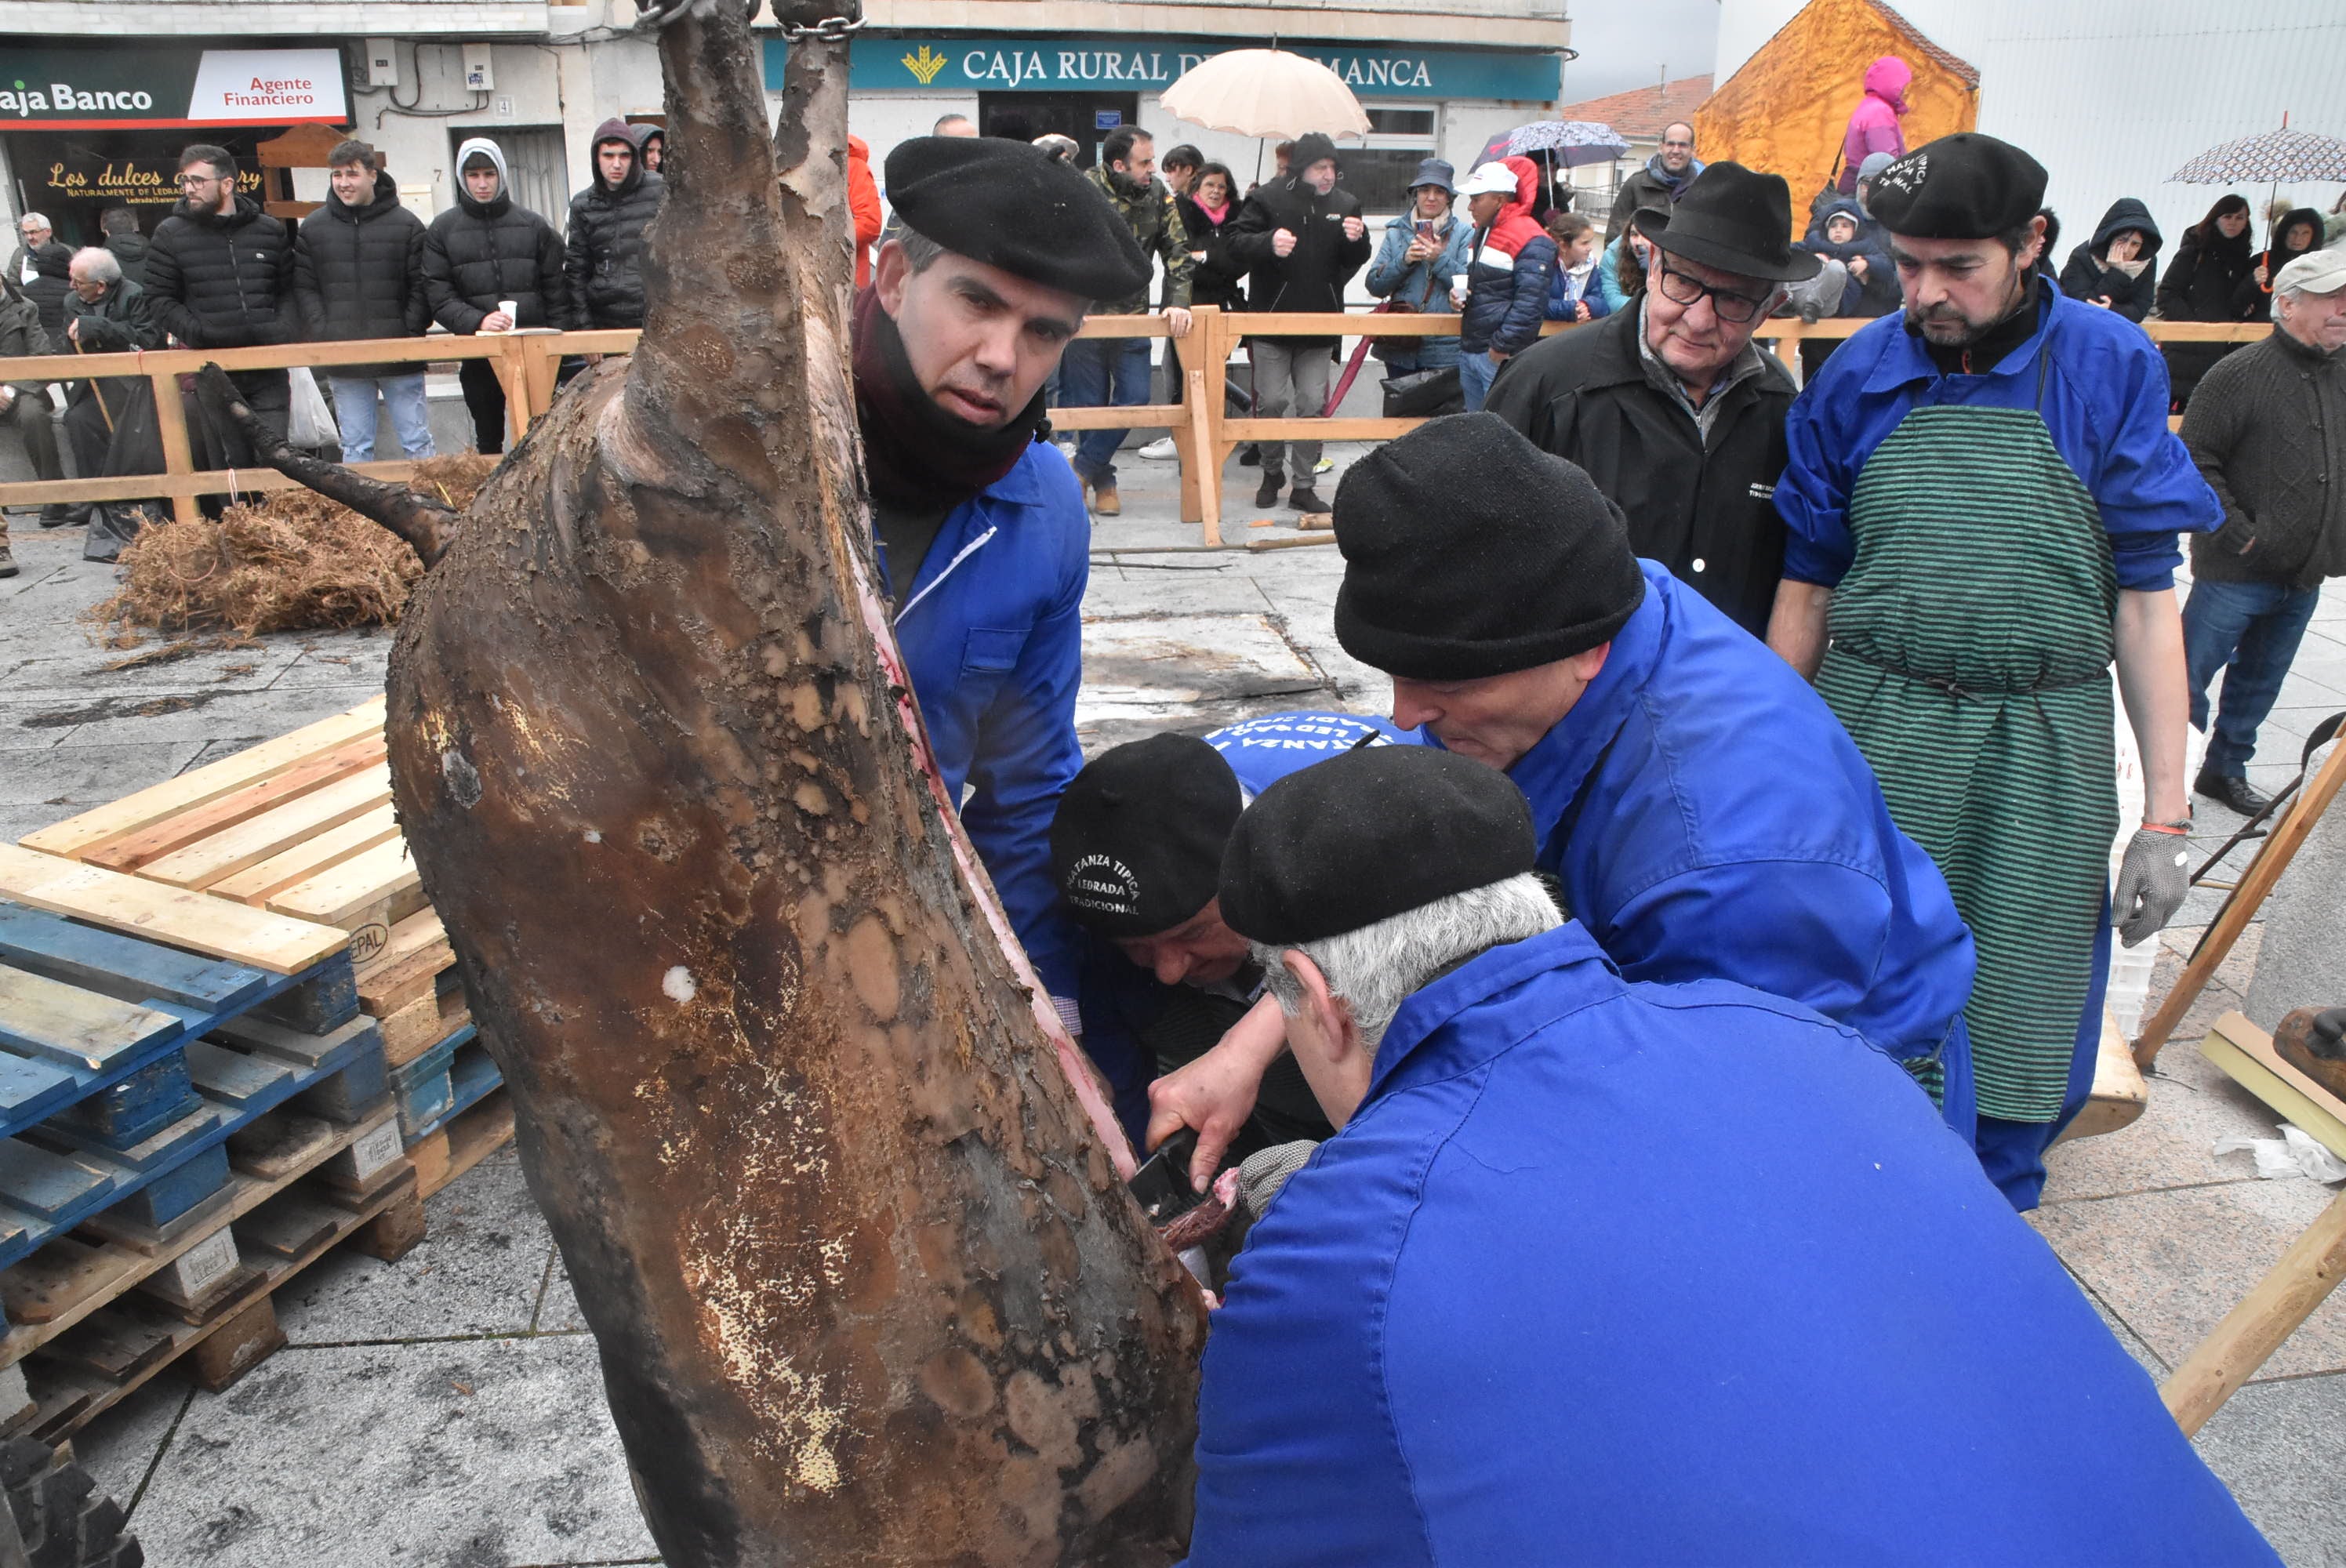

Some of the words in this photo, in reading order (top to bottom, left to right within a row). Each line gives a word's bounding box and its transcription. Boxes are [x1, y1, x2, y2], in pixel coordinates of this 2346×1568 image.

[963, 50, 1048, 87] CAJA
[1057, 51, 1168, 81] RURAL
[1178, 53, 1213, 79] D
[250, 77, 312, 95] Agente
[50, 83, 152, 110] Banco
[223, 92, 314, 106] Financiero
[500, 101, 507, 113] 4
[47, 162, 88, 187] Los
[98, 163, 162, 187] dulces
[434, 169, 442, 182] 7
[67, 188, 135, 198] NATURALMENTE
[152, 187, 185, 196] LEDRAD
[1077, 879, 1126, 895] LEDRADA
[1113, 860, 1141, 901] TIPICA
[1068, 895, 1140, 916] TRADICIONAL
[350, 930, 383, 960] EPAL
